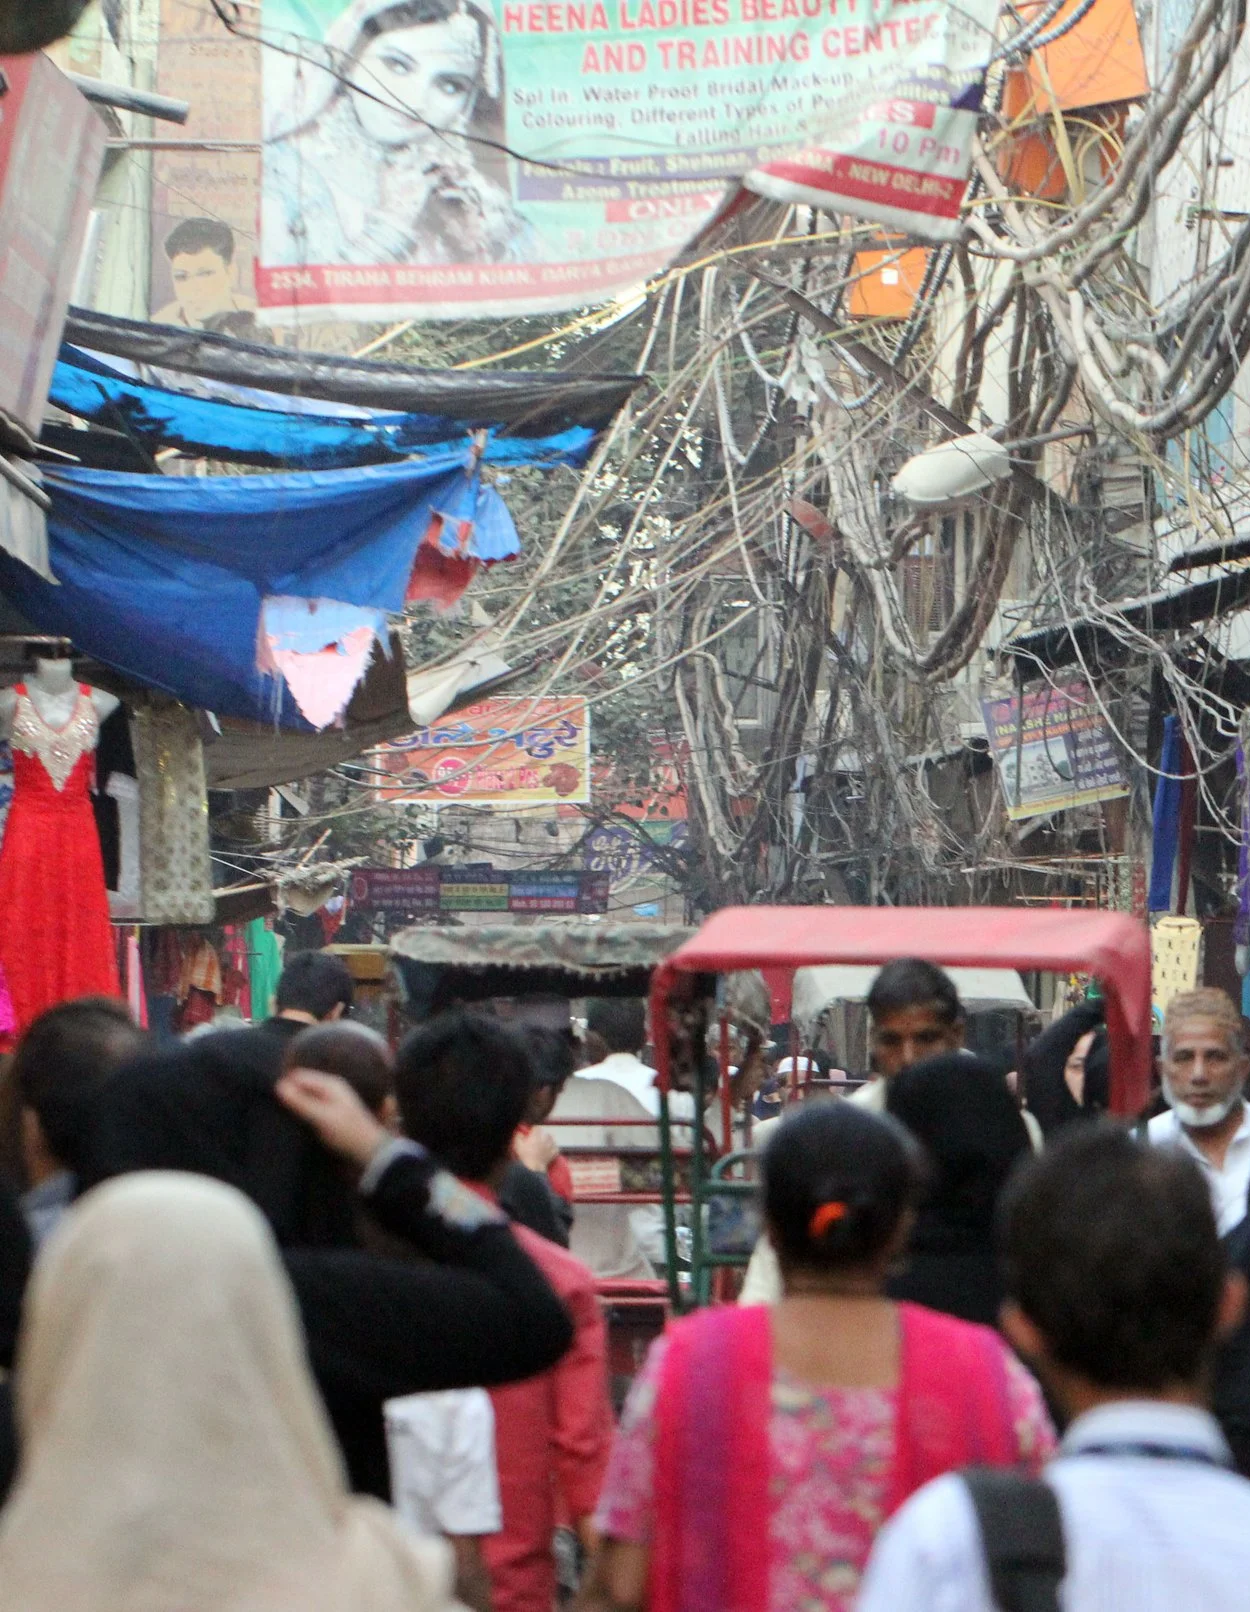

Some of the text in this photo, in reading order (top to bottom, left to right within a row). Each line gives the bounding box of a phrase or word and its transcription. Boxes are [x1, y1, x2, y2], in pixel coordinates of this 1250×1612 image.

[502, 2, 609, 33] HEENA
[618, 0, 730, 30] LADIES
[582, 42, 647, 74] AND
[656, 32, 810, 71] TRAINING
[583, 86, 641, 103] Water
[648, 83, 699, 100] Proof
[707, 78, 765, 98] Bridal
[631, 106, 716, 126] Different
[878, 128, 910, 155] 10
[850, 162, 891, 187] NEW
[628, 192, 722, 219] ONLY
